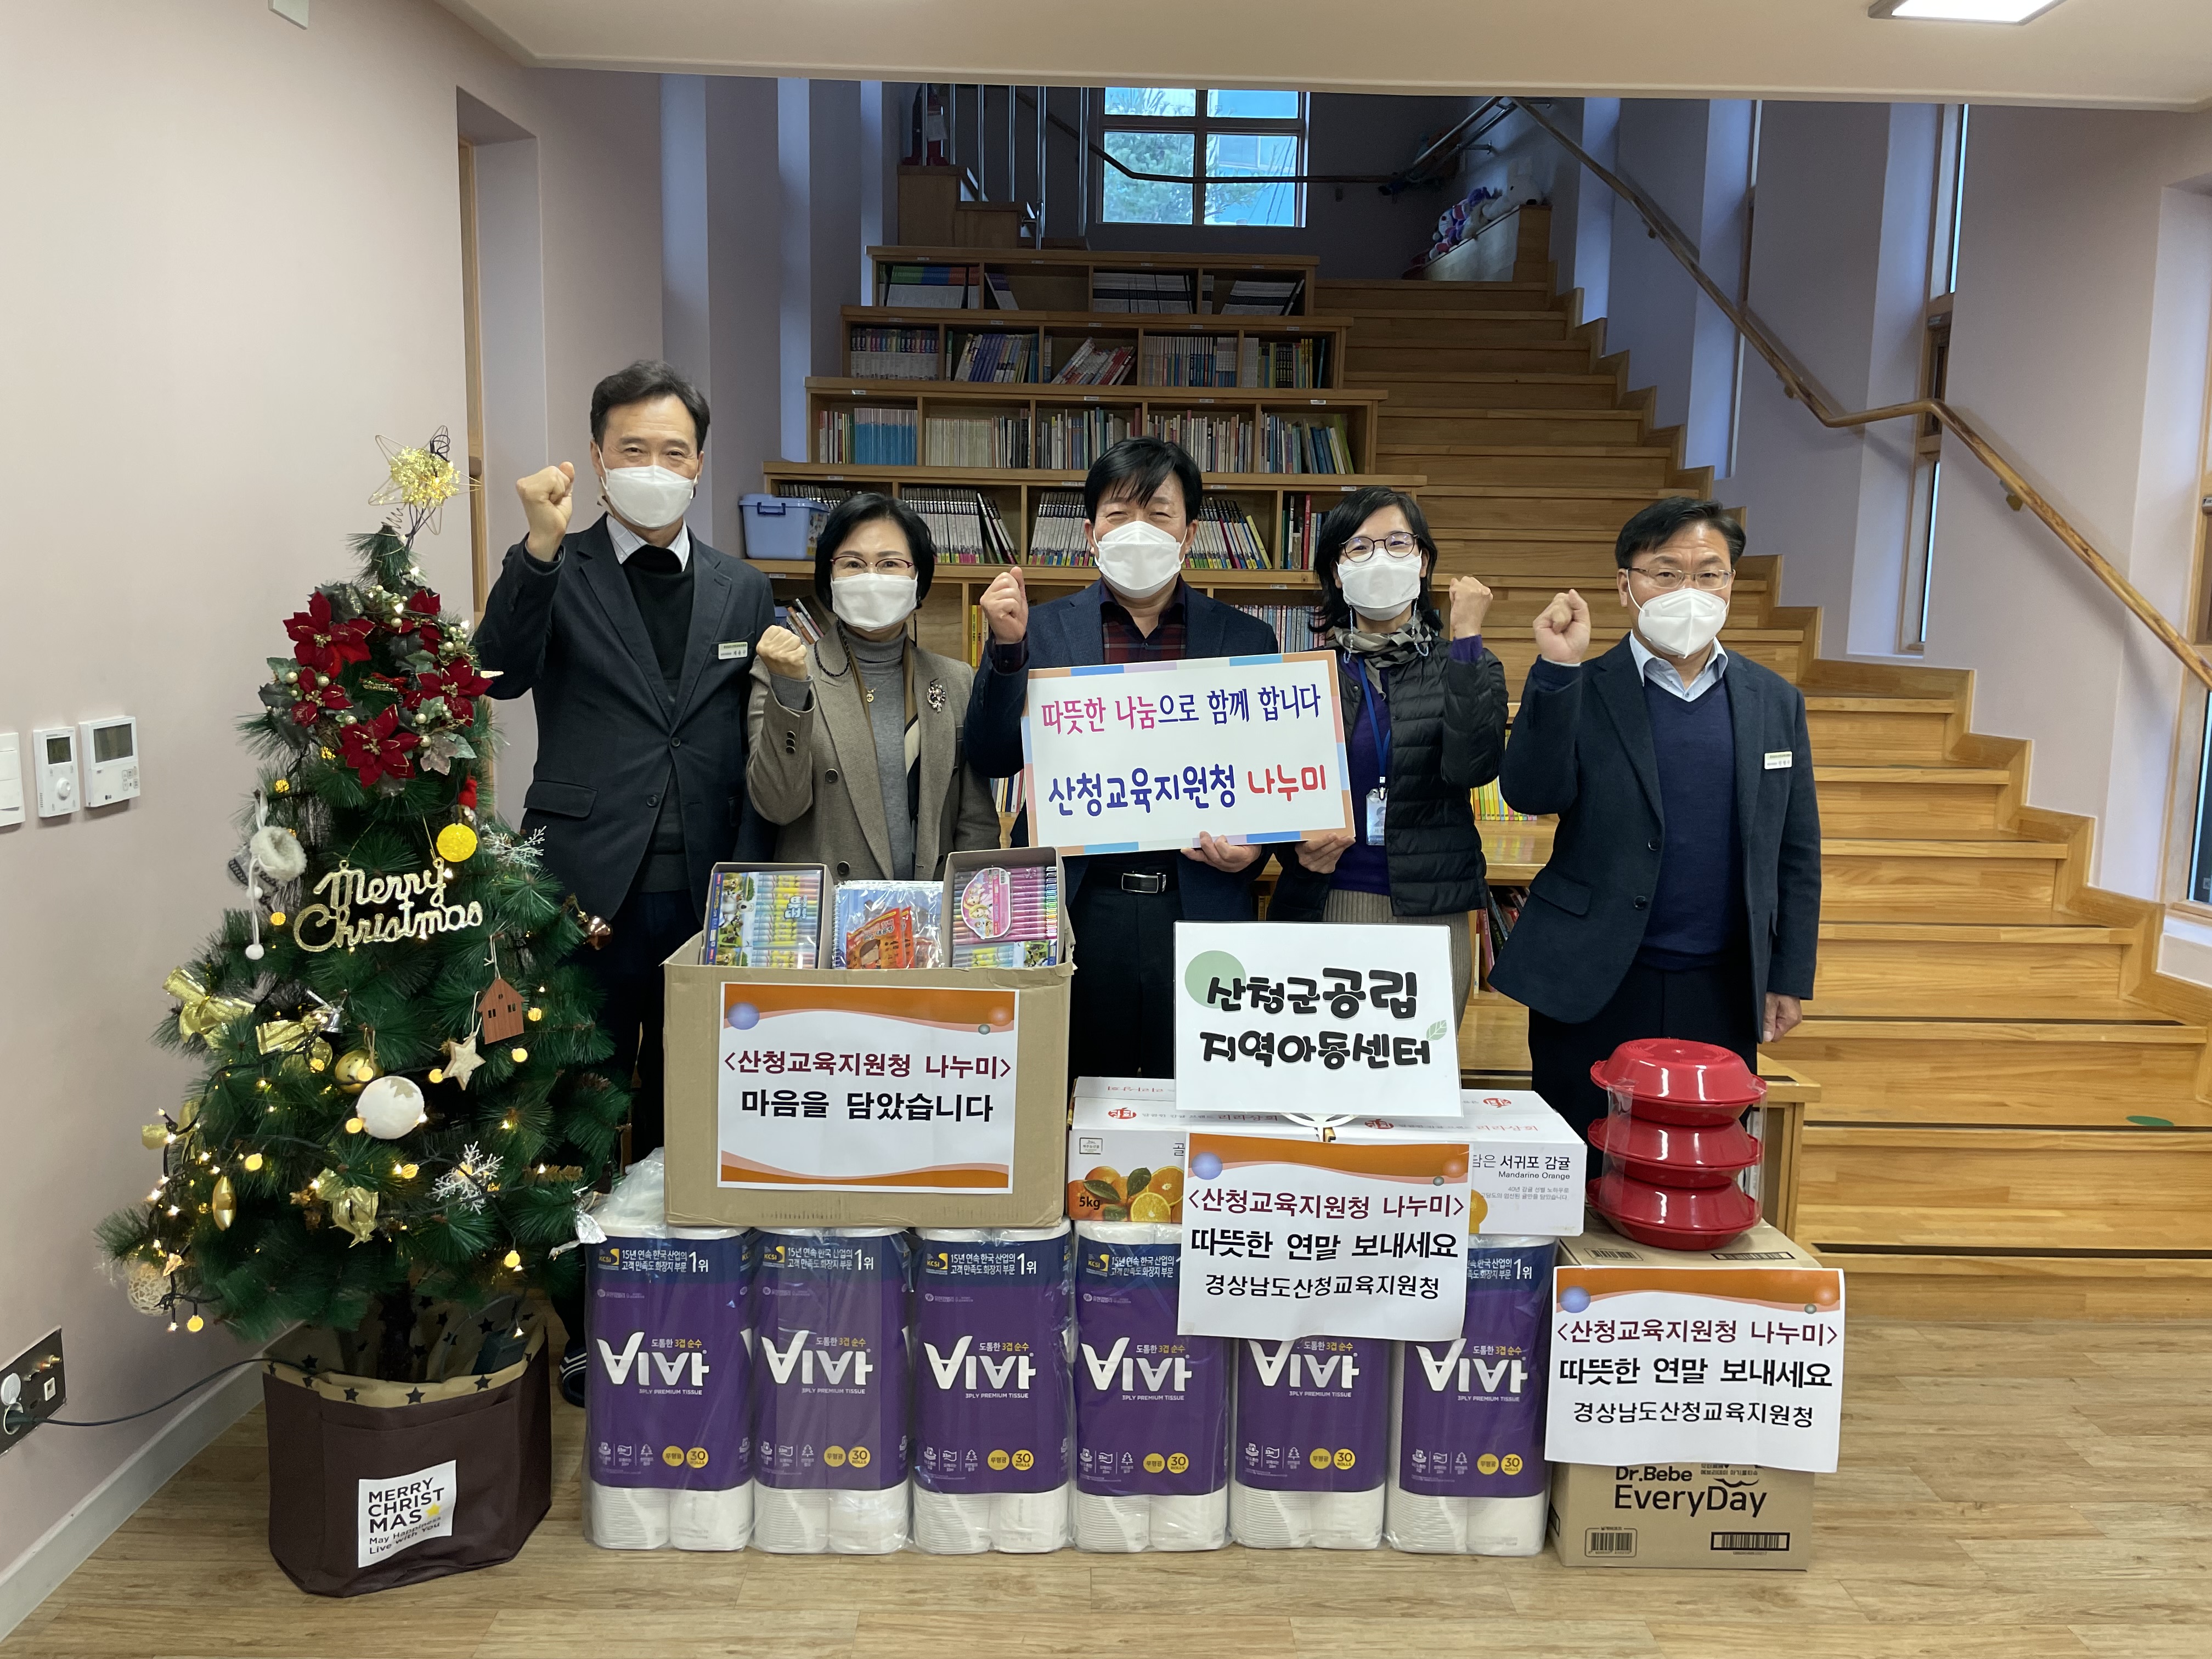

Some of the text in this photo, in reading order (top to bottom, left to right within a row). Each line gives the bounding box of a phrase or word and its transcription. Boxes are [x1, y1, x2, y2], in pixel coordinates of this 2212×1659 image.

[1042, 684, 1321, 735] 따뜻한 나눔으로 함께 합니다
[1048, 764, 1327, 816] 산청교육지원청 나누미
[313, 864, 445, 909] Merry
[294, 901, 483, 952] Christmas
[1200, 1031, 1430, 1069] 지역아동센터
[742, 1090, 993, 1121] 마음을 담았습니다
[1500, 1155, 1539, 1170] 서귀포
[1545, 1156, 1571, 1170] 감귤
[1542, 1172, 1570, 1181] Orange
[1079, 1197, 1101, 1210] 5kg
[1192, 1228, 1458, 1261] 따뜻한 연말 보내세요
[951, 1254, 1015, 1264] 15년 연속 한국 산업의
[1206, 1273, 1439, 1300] 경상남도산청교육지원청
[651, 1339, 702, 1348] 도톰한 3겹 순수
[816, 1337, 866, 1346] 도톰한 3겹 순수
[979, 1342, 1029, 1352] 도톰한 3겹 순수
[1136, 1345, 1186, 1353] 도톰한 3겹 순수
[1304, 1341, 1353, 1351] 도톰한 3겹 순수
[1472, 1346, 1522, 1356] 도톰한 3겹 순수
[1560, 1357, 1832, 1389] 따뜻한 연말 보내세요
[1573, 1402, 1813, 1427] 경상남도산청교육지원청
[690, 1451, 706, 1460] 30
[852, 1451, 867, 1460] 30
[1016, 1453, 1031, 1463] 30
[1171, 1457, 1186, 1466] 30
[1338, 1453, 1352, 1462] 30
[1505, 1458, 1520, 1467] 30
[1616, 1466, 1692, 1481] Dr.Bebe
[369, 1477, 433, 1503] MERRY
[368, 1487, 444, 1517] CHRIST
[1615, 1484, 1768, 1517] EveryDay
[370, 1509, 422, 1533] MAS
[370, 1516, 441, 1545] May Happiness
[370, 1522, 440, 1554] Live with You
